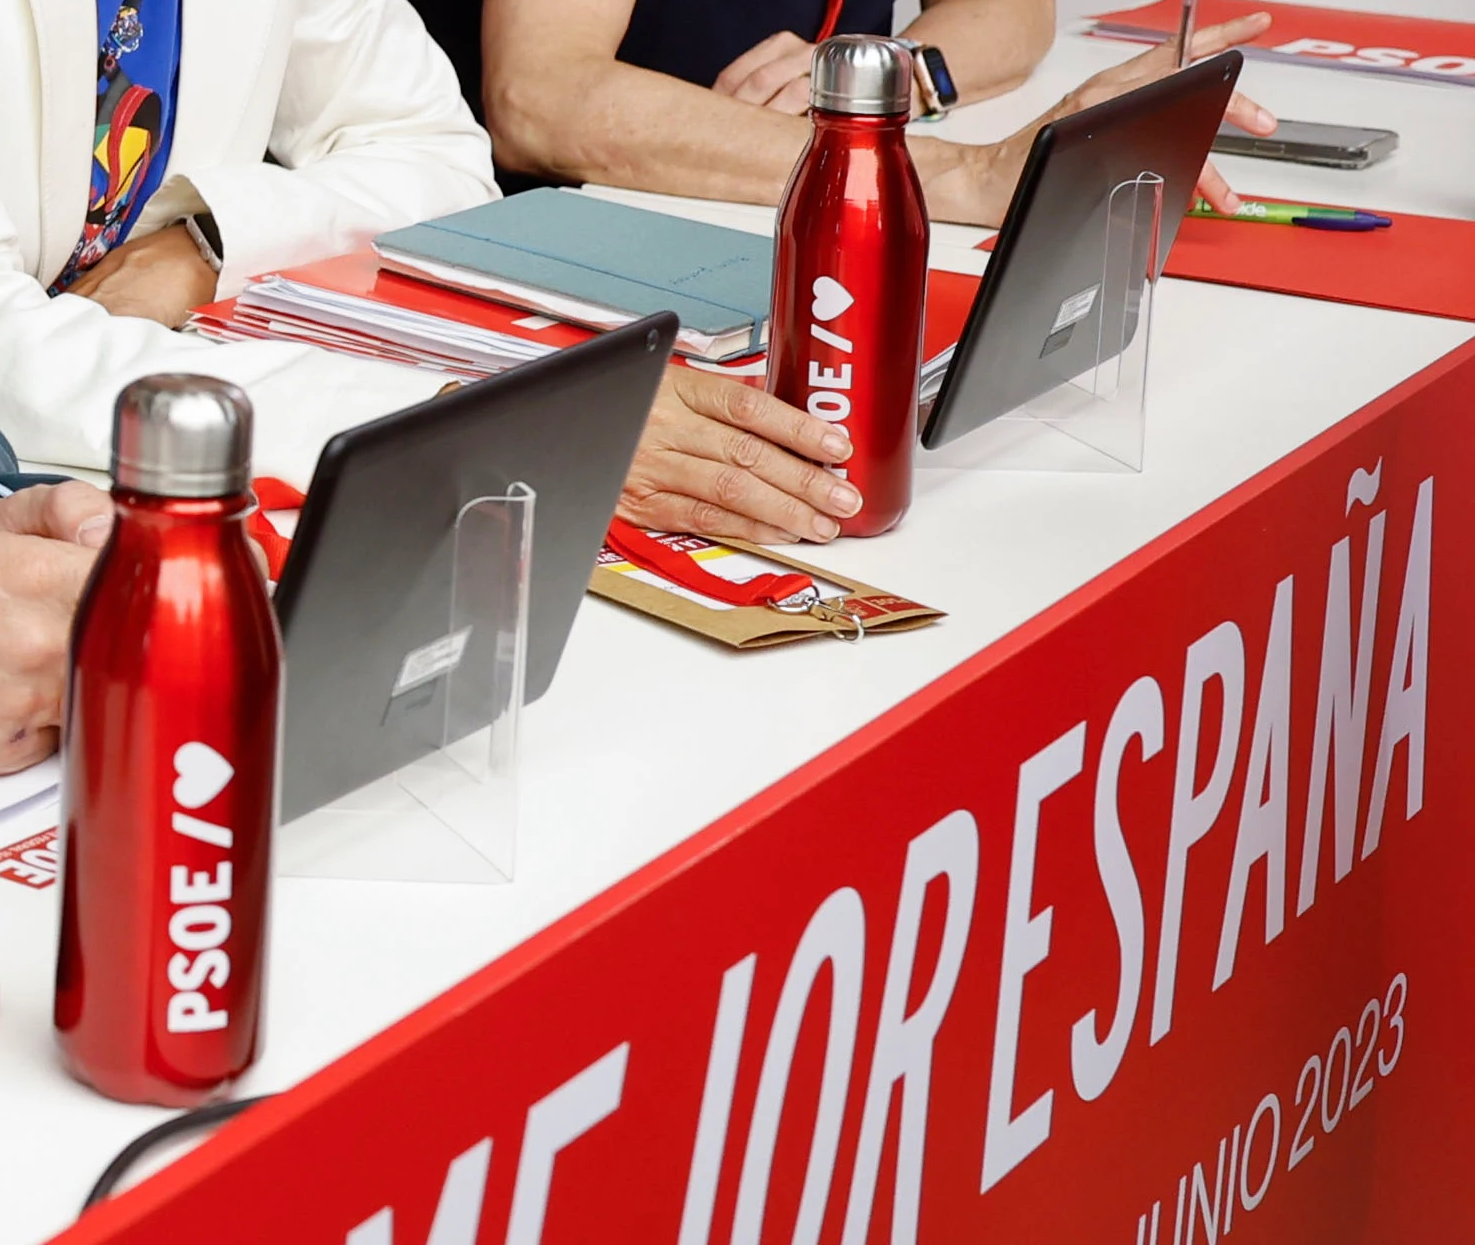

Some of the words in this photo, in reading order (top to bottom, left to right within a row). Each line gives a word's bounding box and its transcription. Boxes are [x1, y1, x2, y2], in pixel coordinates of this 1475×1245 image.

[345, 809, 979, 1245] JOR
[980, 455, 1436, 1196] ESPAÑA
[1136, 1093, 1281, 1245] NIO
[1288, 972, 1408, 1172] 2023
